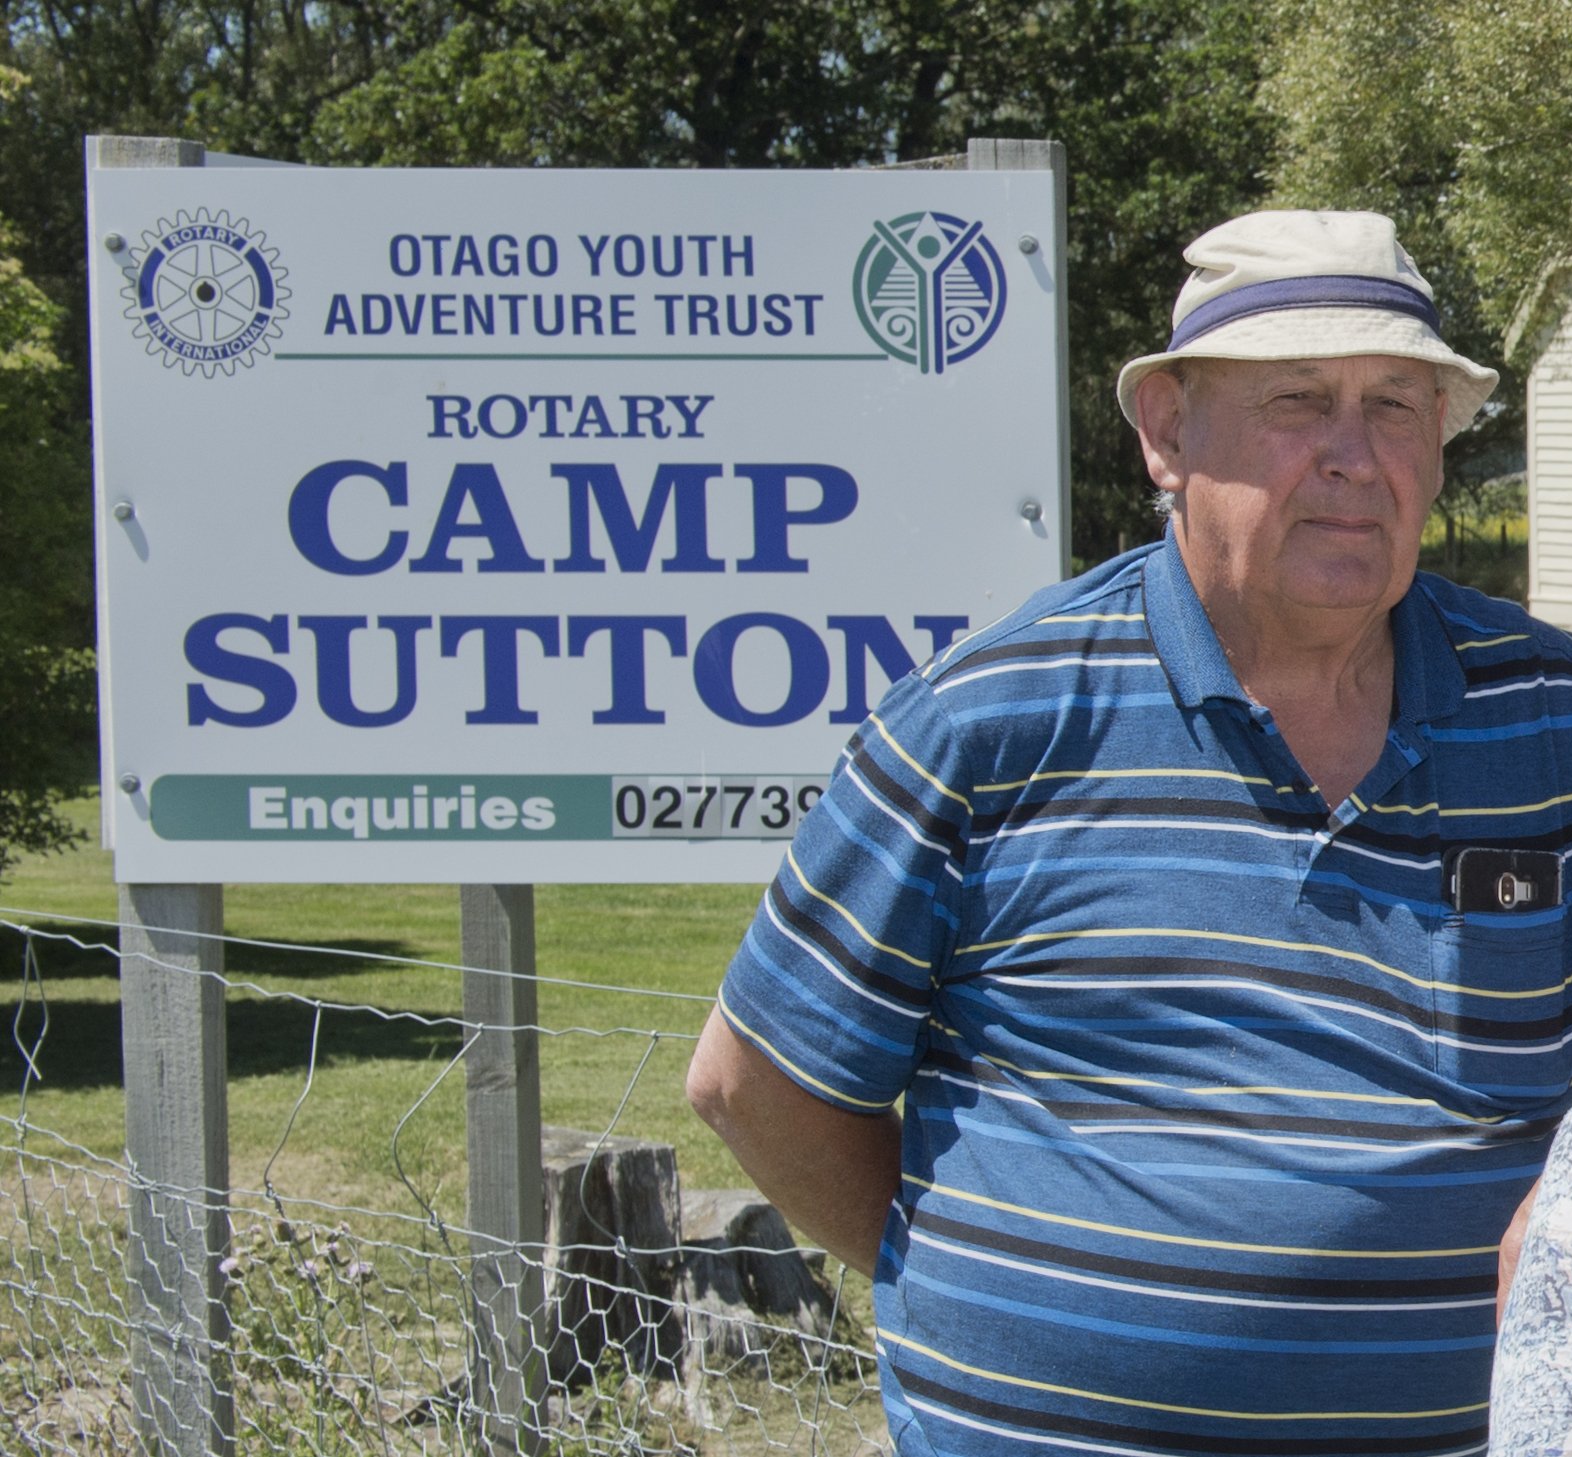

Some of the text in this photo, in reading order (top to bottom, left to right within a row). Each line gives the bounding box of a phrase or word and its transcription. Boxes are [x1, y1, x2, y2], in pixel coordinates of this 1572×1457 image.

[169, 227, 240, 247] ROTARY
[388, 234, 755, 278] OTAGO YOUTH
[323, 293, 824, 337] ADVENTURE TRUST
[150, 319, 267, 360] INTERNATIONAL
[426, 394, 715, 440] ROTARY
[287, 459, 860, 578] CAMP
[183, 611, 970, 730] SUTTON
[248, 785, 556, 838] Enquiries
